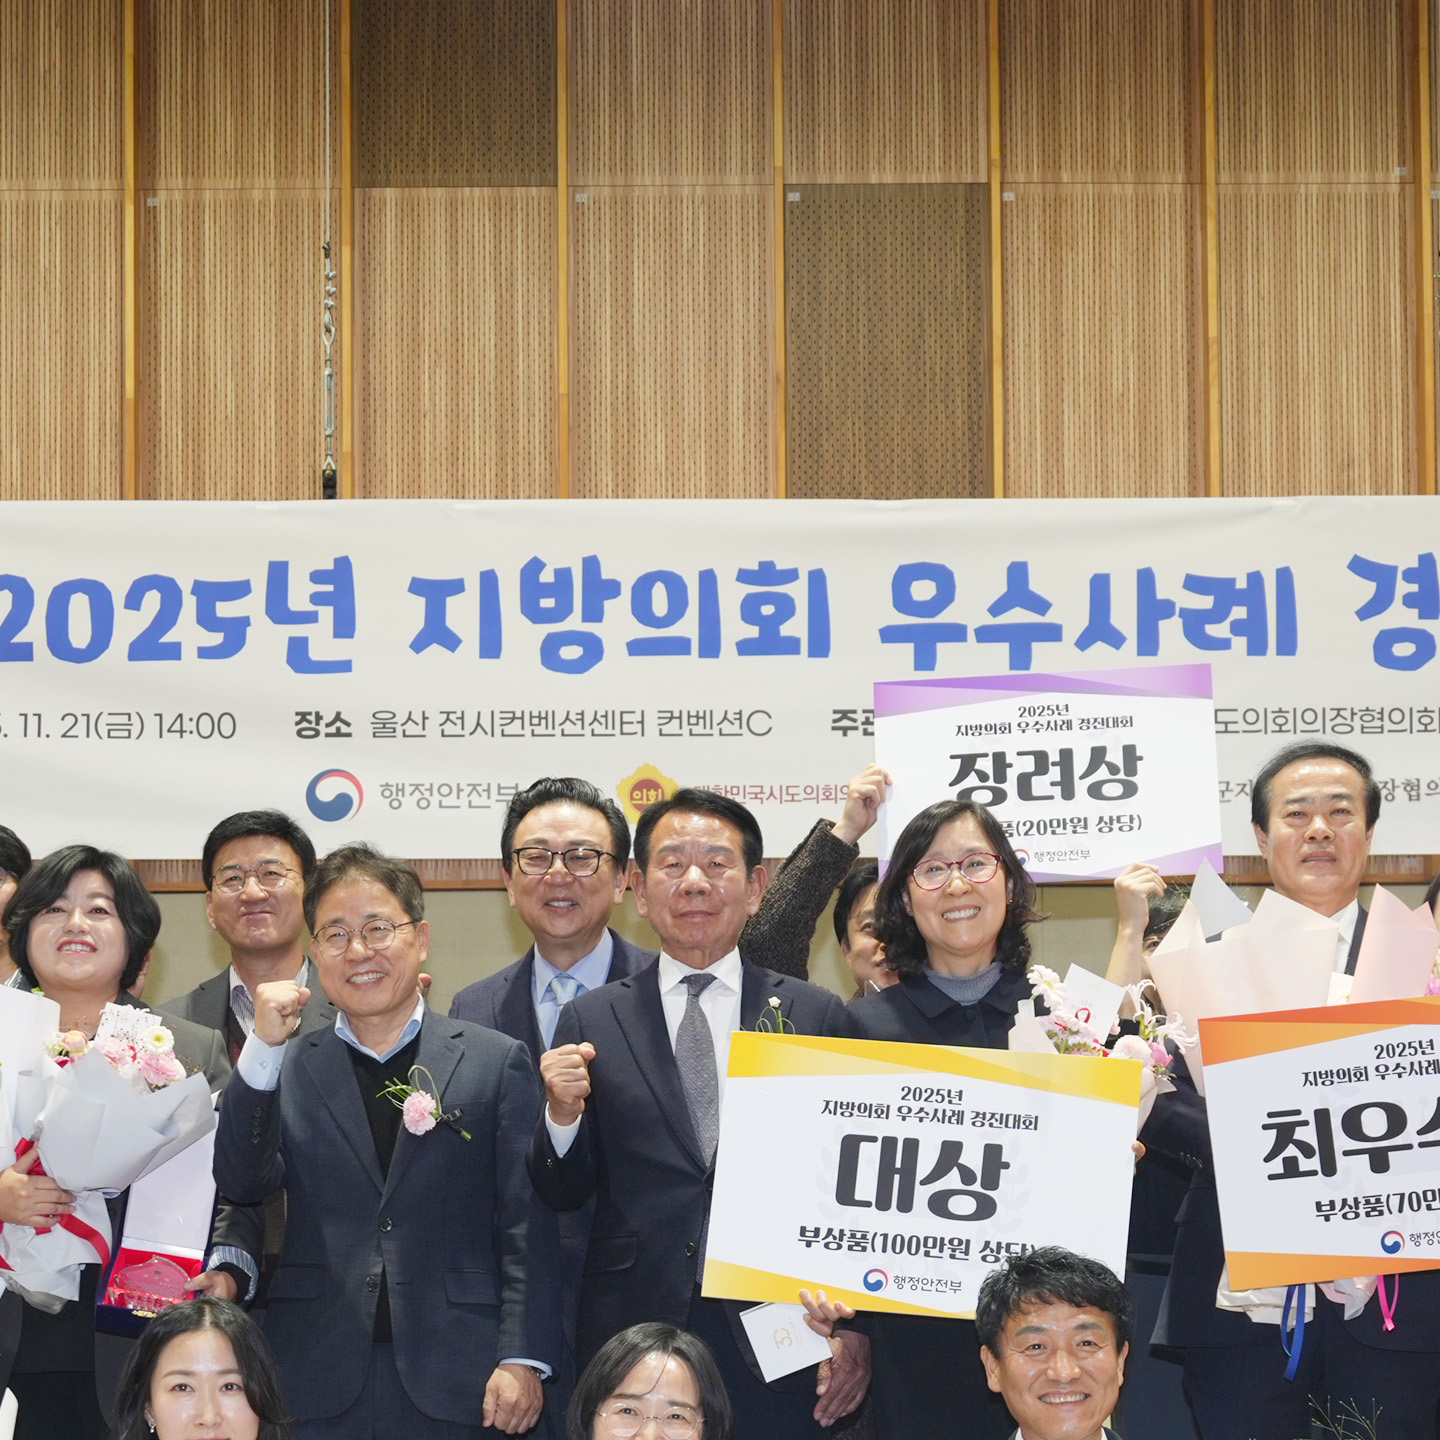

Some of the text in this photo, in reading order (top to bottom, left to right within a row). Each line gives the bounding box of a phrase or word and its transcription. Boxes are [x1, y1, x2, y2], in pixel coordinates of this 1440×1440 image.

[408, 554, 831, 675] 지방의회
[878, 560, 1299, 671] 우수사례
[293, 709, 773, 740] 장소 울산 전시컨벤션센터 컨벤션C
[1018, 703, 1069, 718] 2025년
[19, 713, 51, 738] 11.
[60, 710, 145, 740] 21(금)
[154, 712, 238, 740] 14:00
[955, 715, 1134, 737] 지방의회 우수사례 경진대회
[948, 743, 1144, 808] 장려상
[379, 782, 519, 810] 행정안전부
[631, 787, 662, 805] 의회
[1095, 814, 1143, 834] 상당)
[1033, 849, 1091, 863] 행정안전부
[1374, 1039, 1435, 1060] 2025년
[1302, 1065, 1369, 1088] 지방의회
[1374, 1059, 1440, 1081] 우수사례
[900, 1085, 964, 1106] 2025년
[821, 1099, 1039, 1132] 지방의회 우수사례 경진대회
[835, 1133, 1010, 1222] 대상
[798, 1225, 971, 1261] 부상품(100만원
[893, 1274, 963, 1294] 행정안전부
